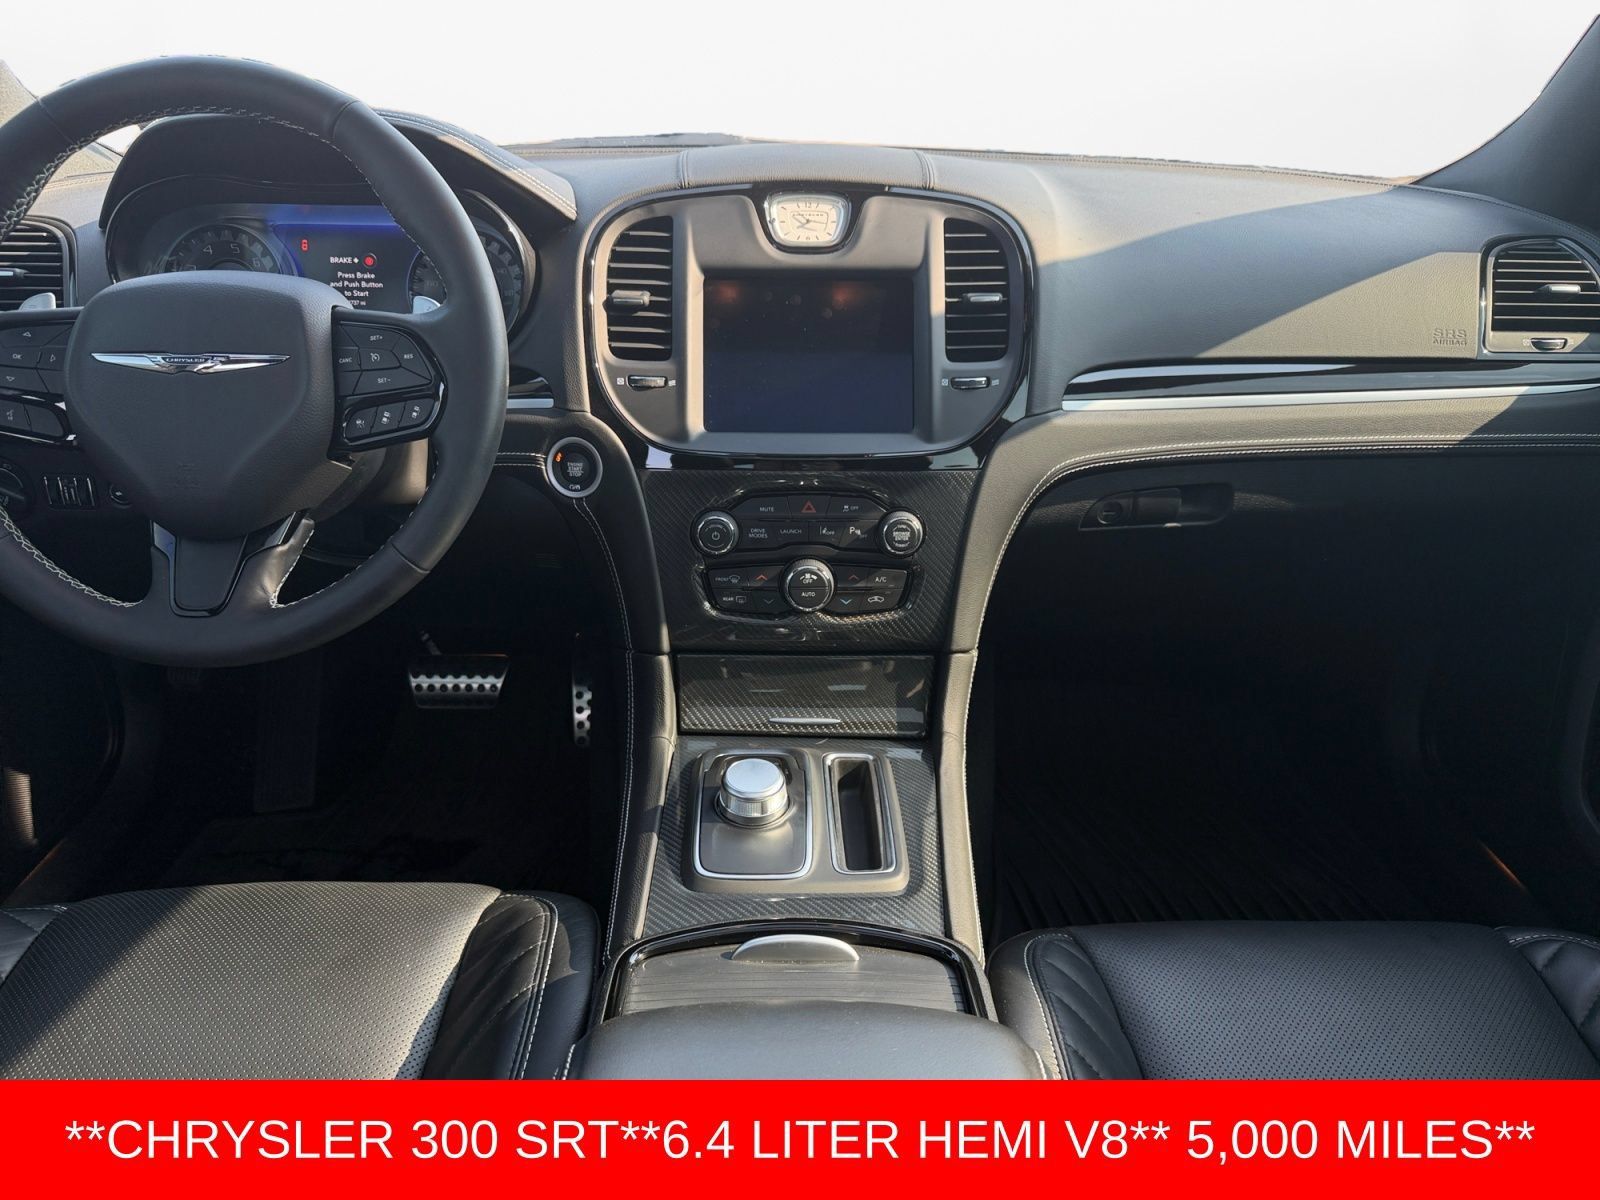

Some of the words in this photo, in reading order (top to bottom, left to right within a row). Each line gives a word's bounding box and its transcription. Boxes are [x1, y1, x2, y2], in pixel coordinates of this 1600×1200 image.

[203, 245, 213, 255] 4
[230, 243, 241, 254] 5
[330, 256, 353, 264] BRAKE
[1433, 328, 1468, 338] SRS
[1432, 338, 1468, 347] AIRBAG
